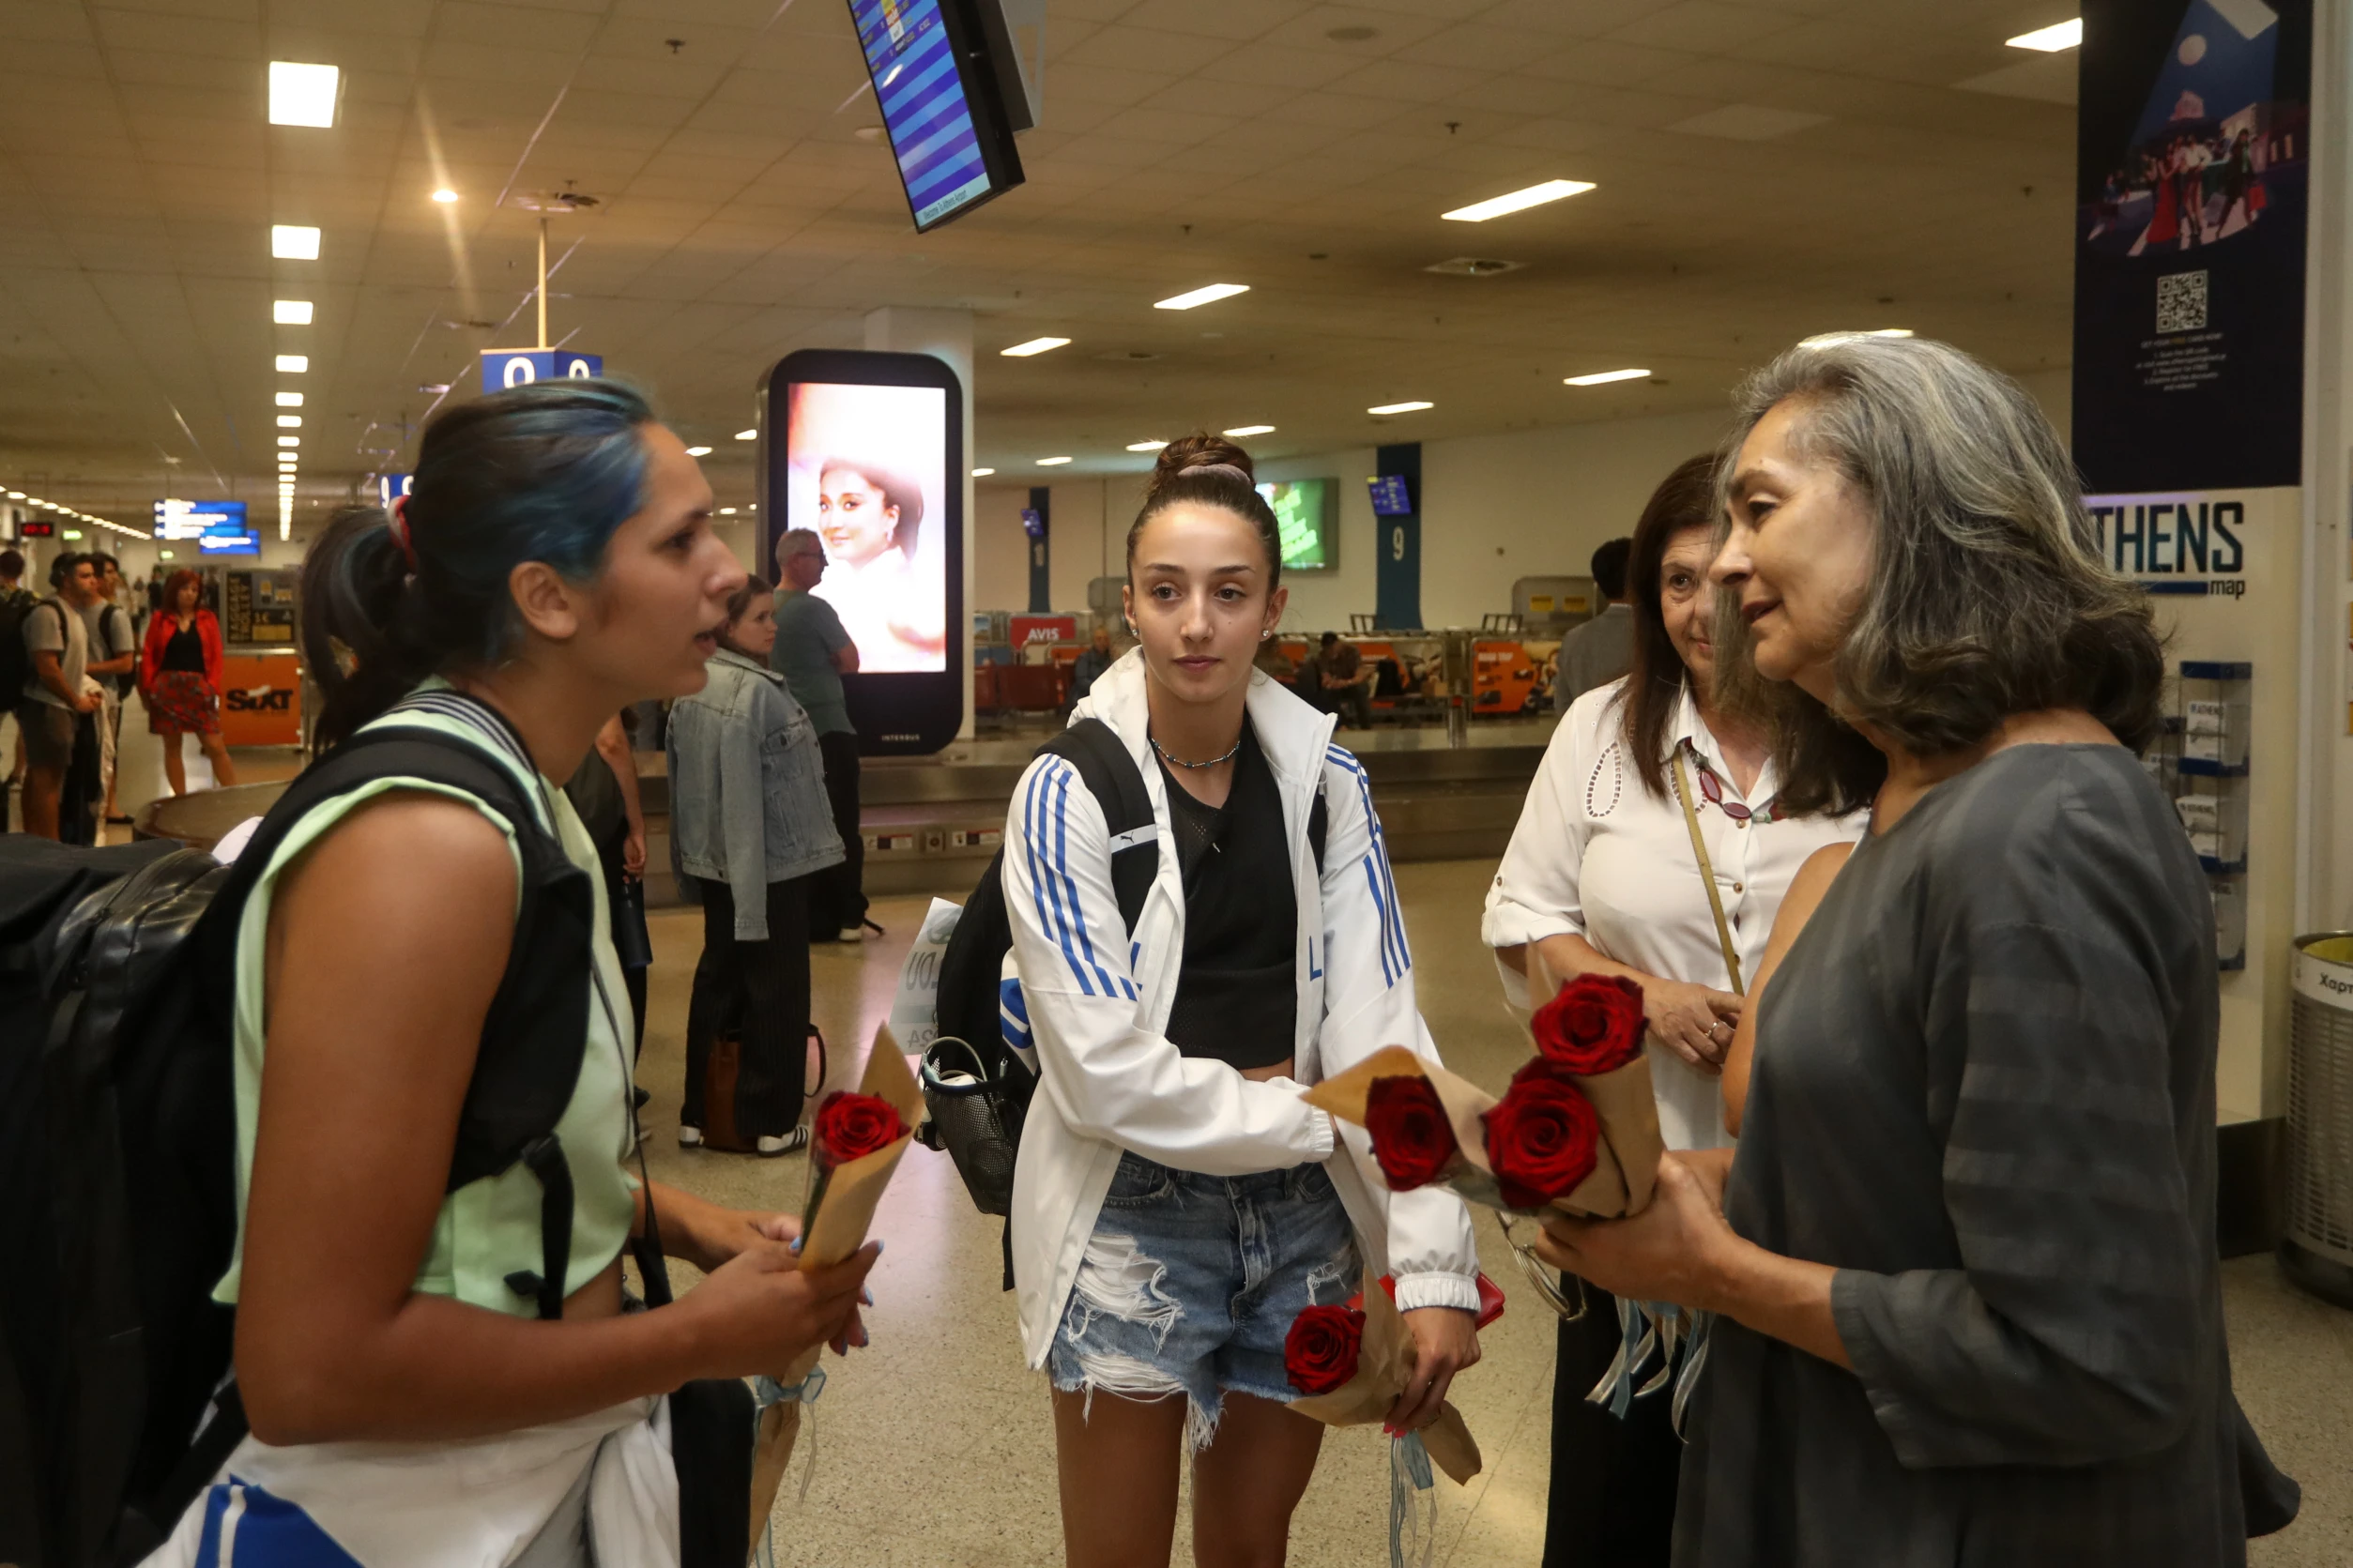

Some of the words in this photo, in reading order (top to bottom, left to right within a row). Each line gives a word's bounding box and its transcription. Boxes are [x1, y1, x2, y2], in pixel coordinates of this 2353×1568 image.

[1392, 525, 1405, 562] 9
[2091, 502, 2244, 573] THENS
[2210, 579, 2245, 601] map
[1028, 628, 1061, 641] AVIS
